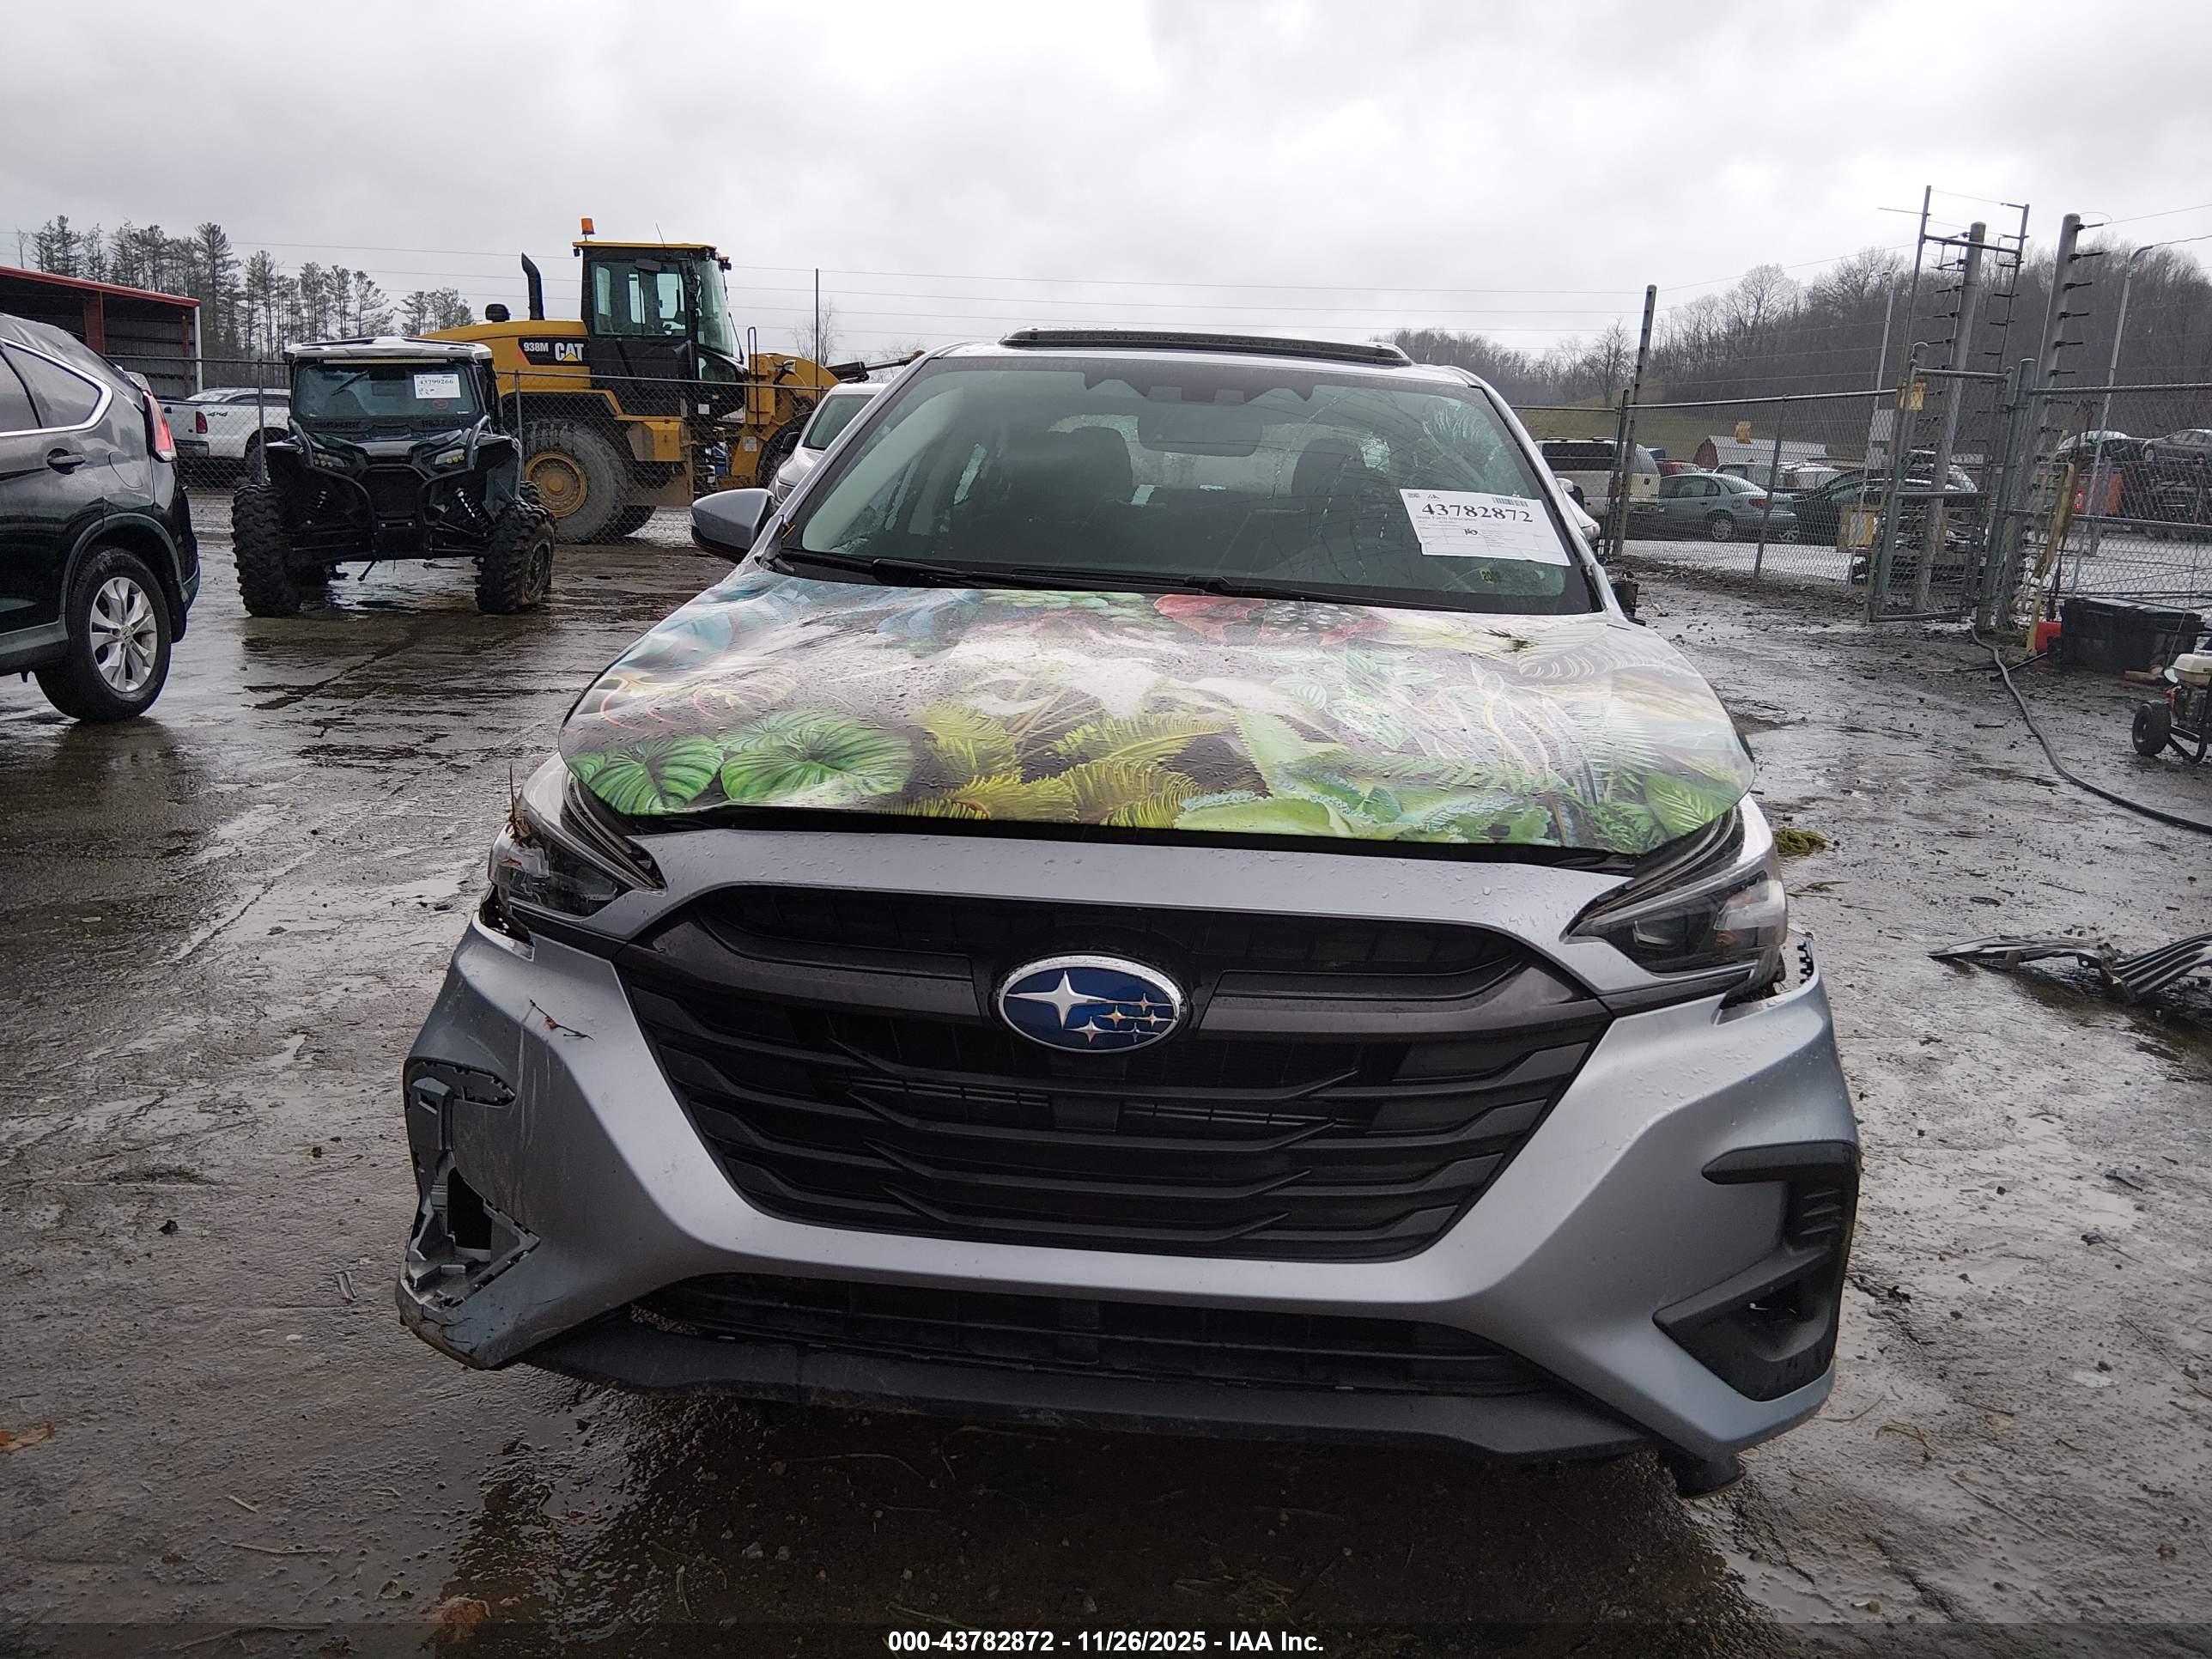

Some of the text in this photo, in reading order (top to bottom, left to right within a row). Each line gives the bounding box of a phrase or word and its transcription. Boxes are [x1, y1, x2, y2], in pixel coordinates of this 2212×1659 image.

[522, 342, 550, 353] 938M
[554, 342, 585, 362] CAT
[1421, 502, 1534, 523] 43782872
